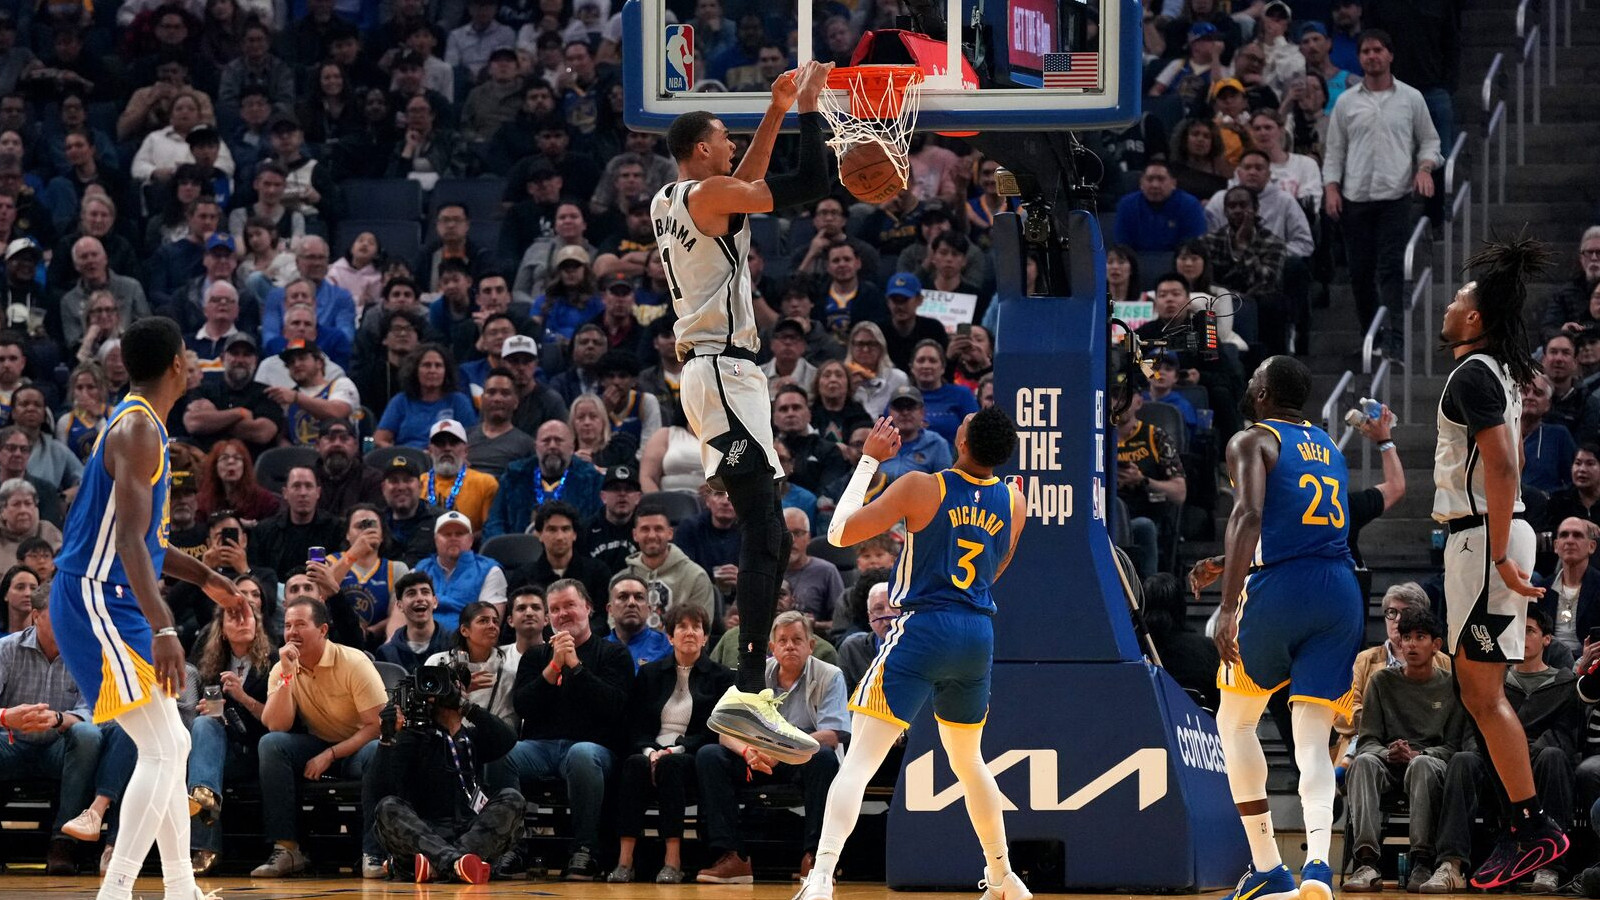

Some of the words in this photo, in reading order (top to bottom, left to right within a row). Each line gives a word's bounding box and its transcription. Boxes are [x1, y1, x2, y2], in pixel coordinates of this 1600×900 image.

[669, 78, 683, 88] NBA
[662, 247, 683, 300] 1
[1016, 387, 1062, 427] GET
[1016, 431, 1062, 470] THE
[1296, 442, 1330, 466] GREEN
[1026, 476, 1073, 526] App
[1298, 473, 1345, 528] 23
[948, 505, 1005, 537] RICHARD
[951, 538, 985, 590] 3
[355, 597, 369, 612] 30
